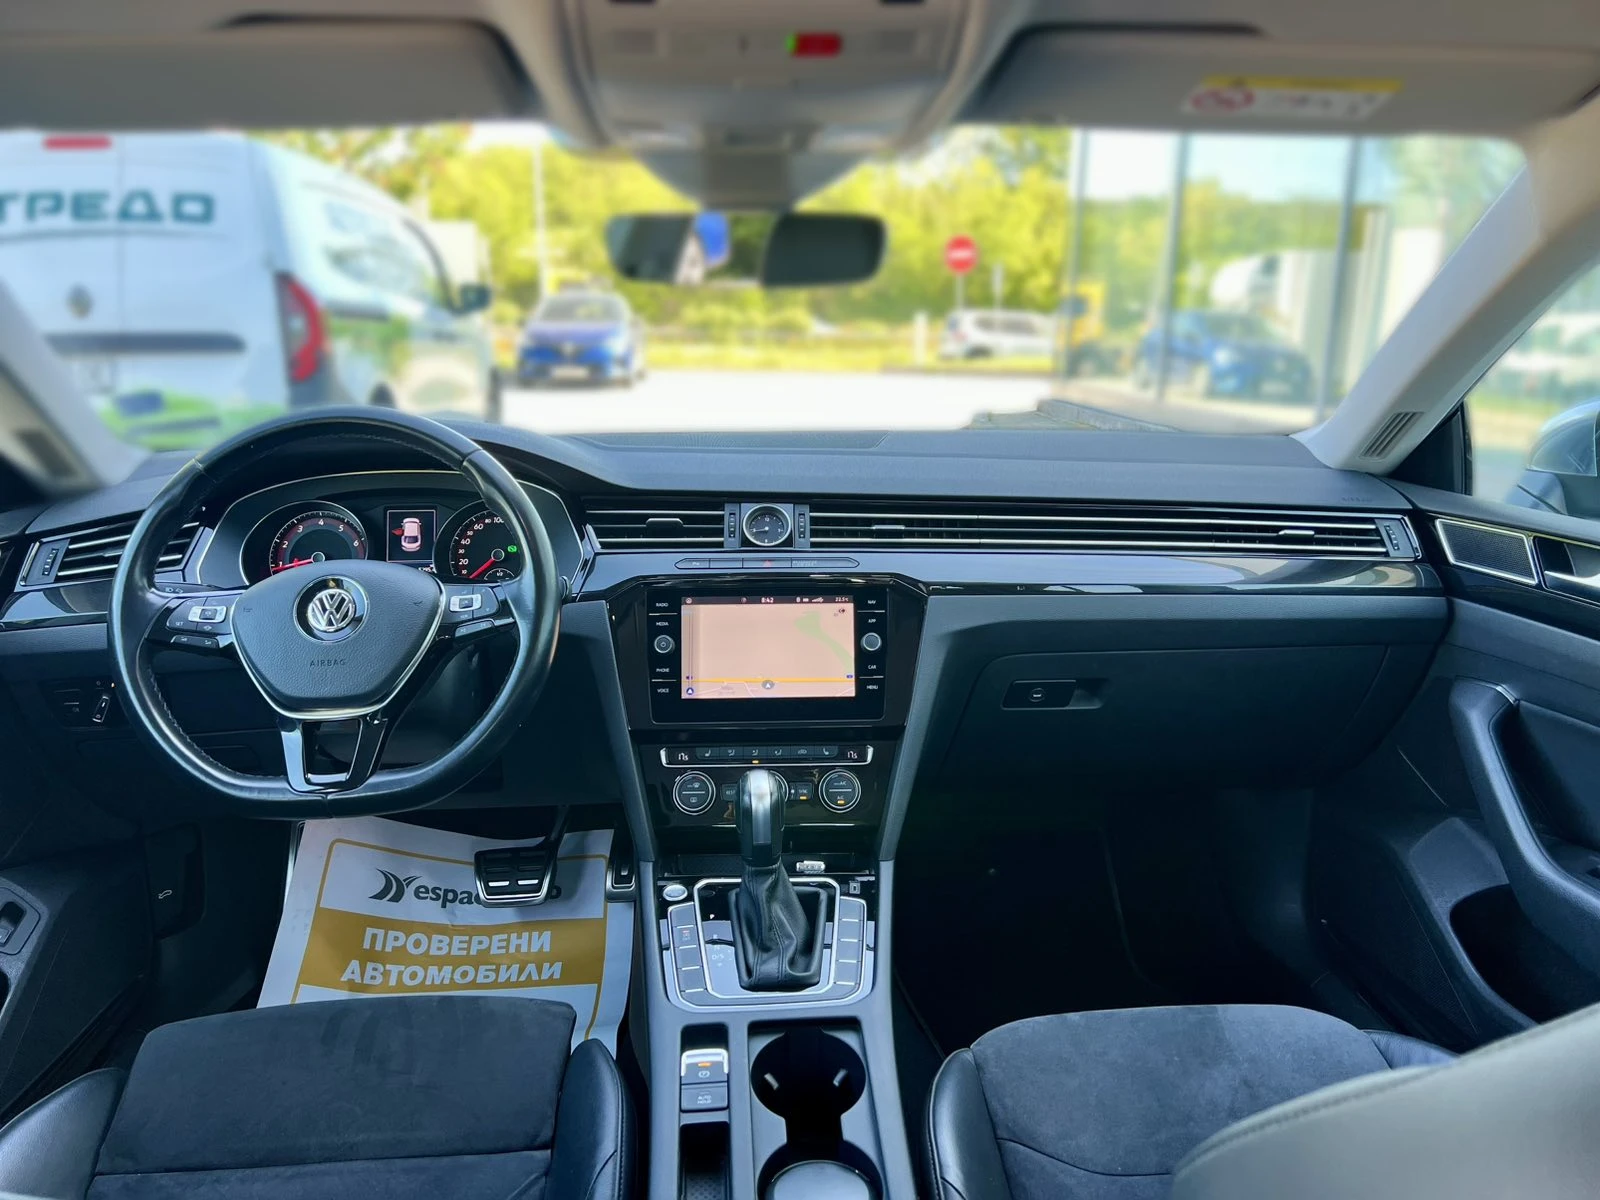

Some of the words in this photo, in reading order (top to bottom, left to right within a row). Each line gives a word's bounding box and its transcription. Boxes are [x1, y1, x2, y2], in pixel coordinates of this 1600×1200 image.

[297, 525, 303, 533] 3
[338, 524, 344, 532] 5
[309, 659, 347, 667] AIRBAG
[363, 927, 551, 956] ПРОВЕРЕНИ
[340, 960, 562, 986] АВТОМОБИЛИ
